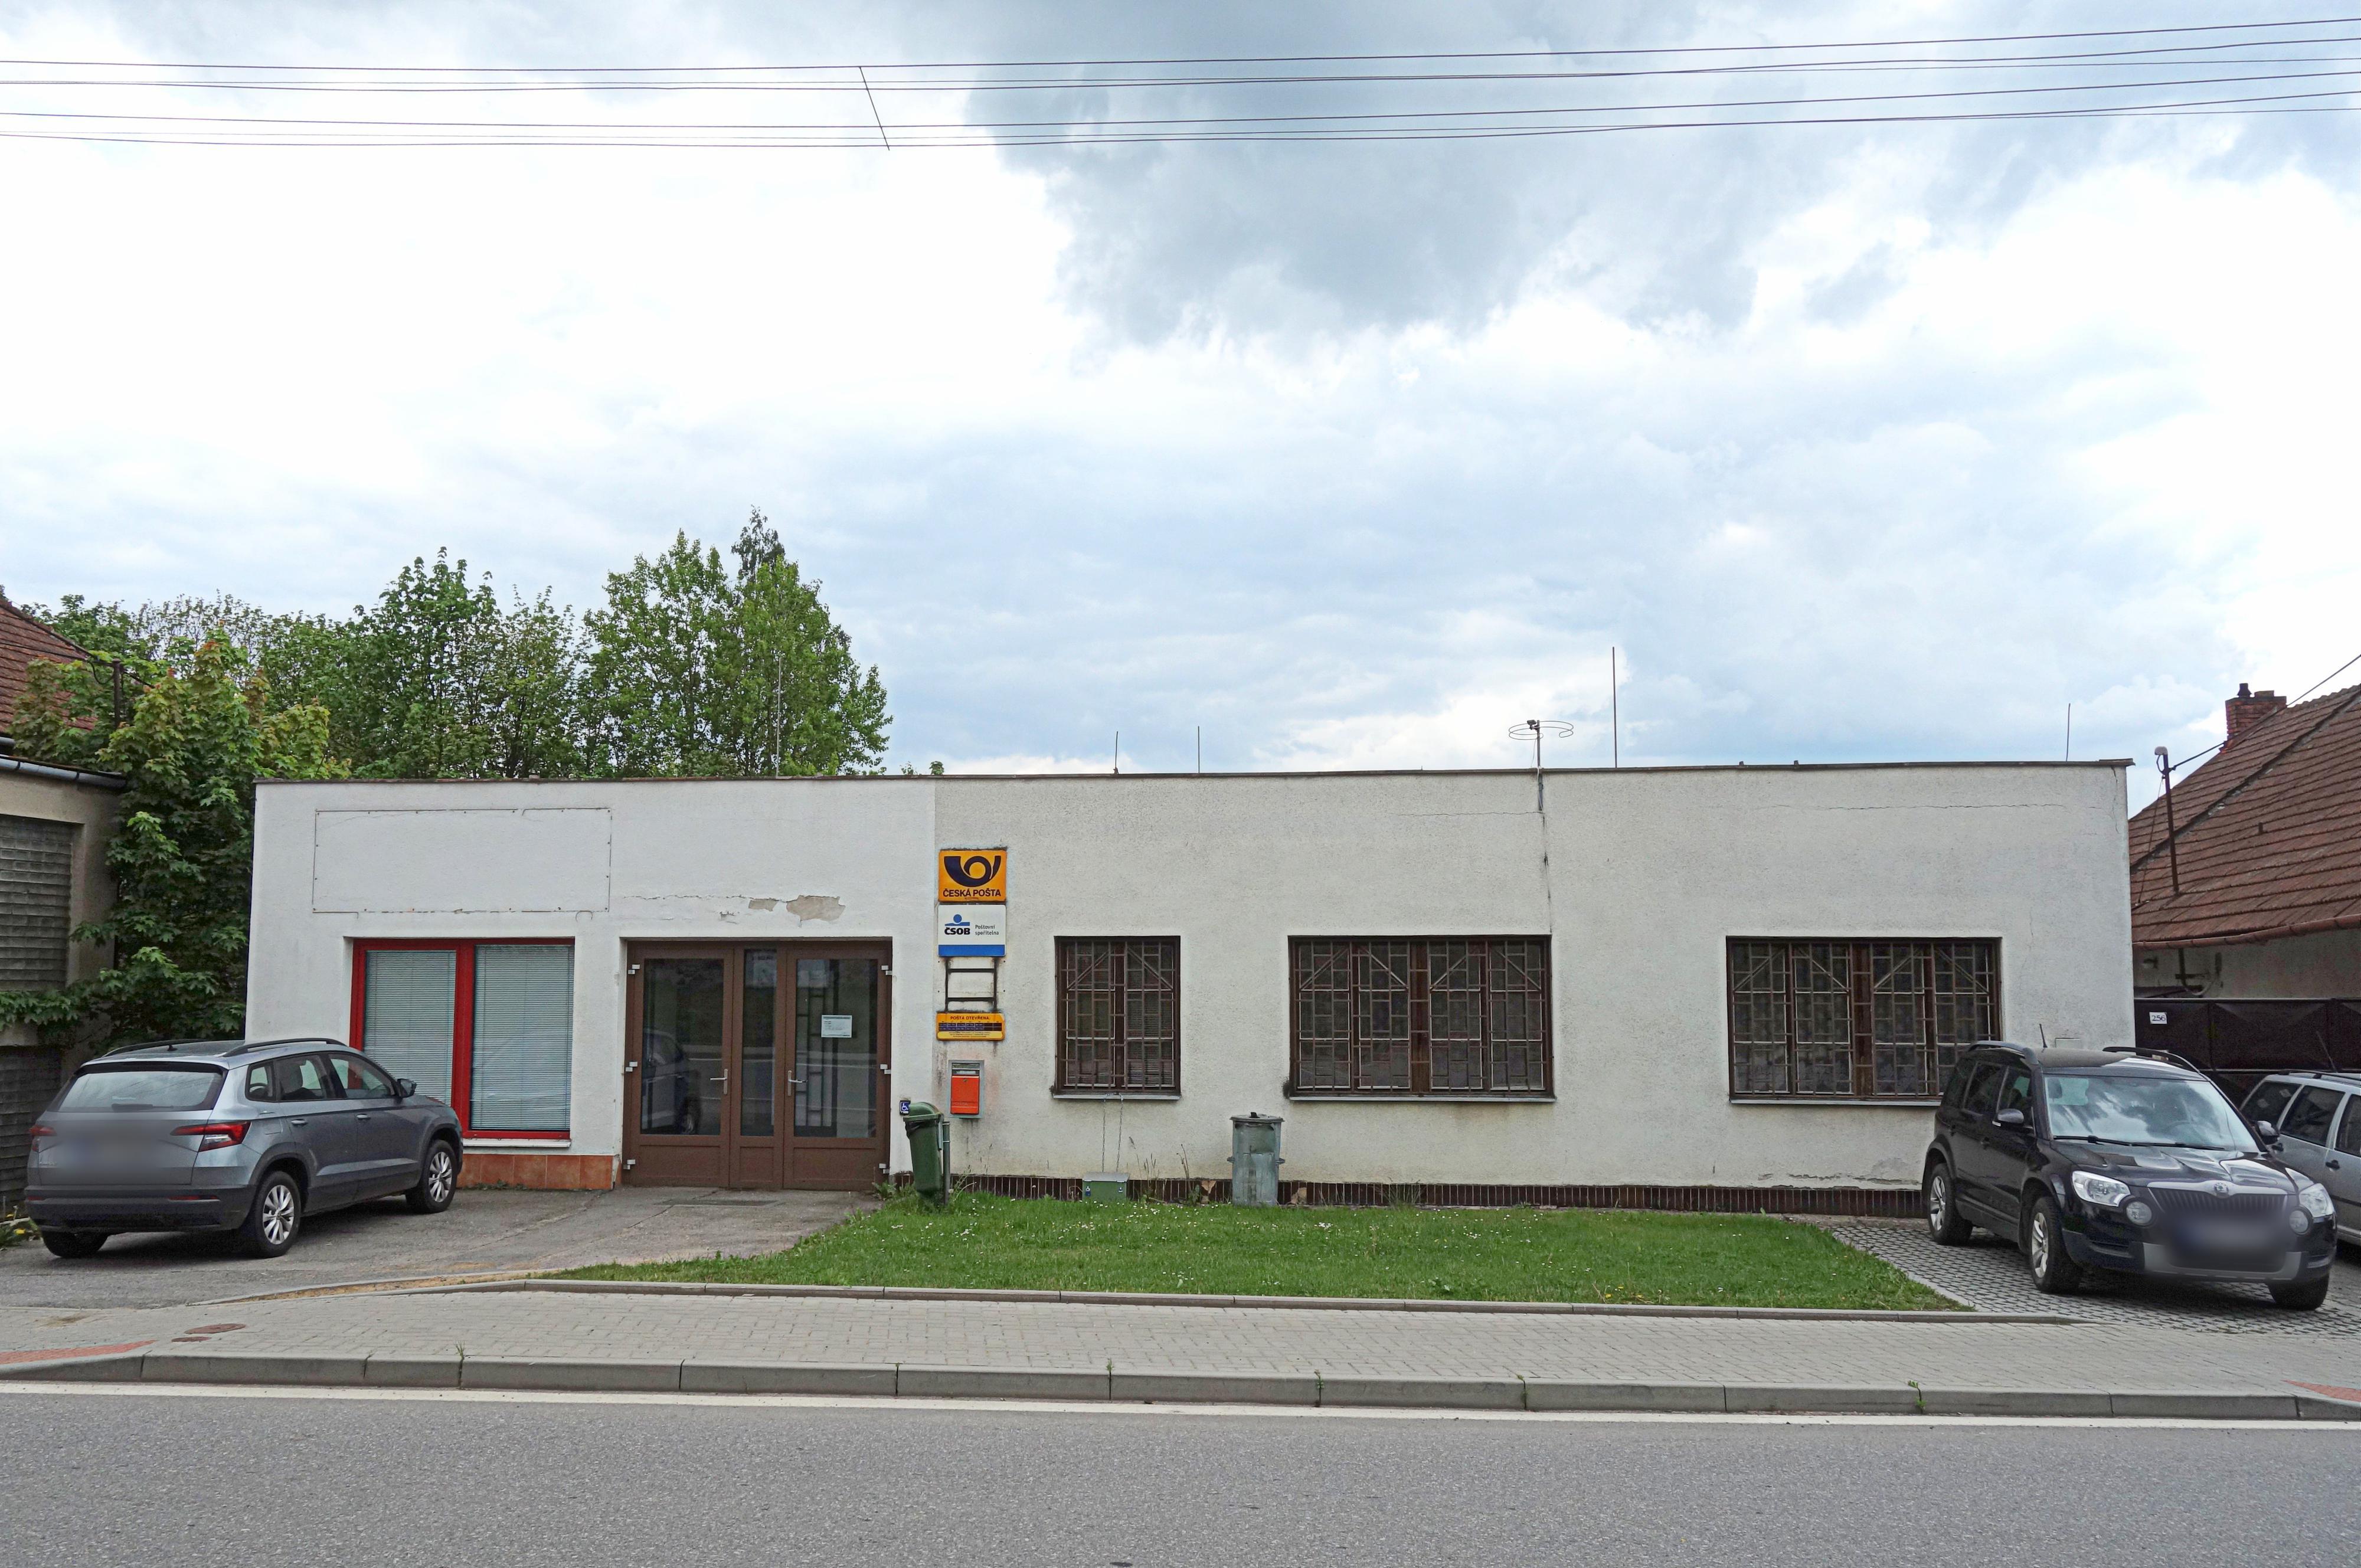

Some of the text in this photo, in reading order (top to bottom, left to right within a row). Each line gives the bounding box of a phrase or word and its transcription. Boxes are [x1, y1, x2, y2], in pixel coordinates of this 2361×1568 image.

[943, 888, 1001, 897] ČESKÁ POŠTA
[944, 927, 970, 935] ČSOB
